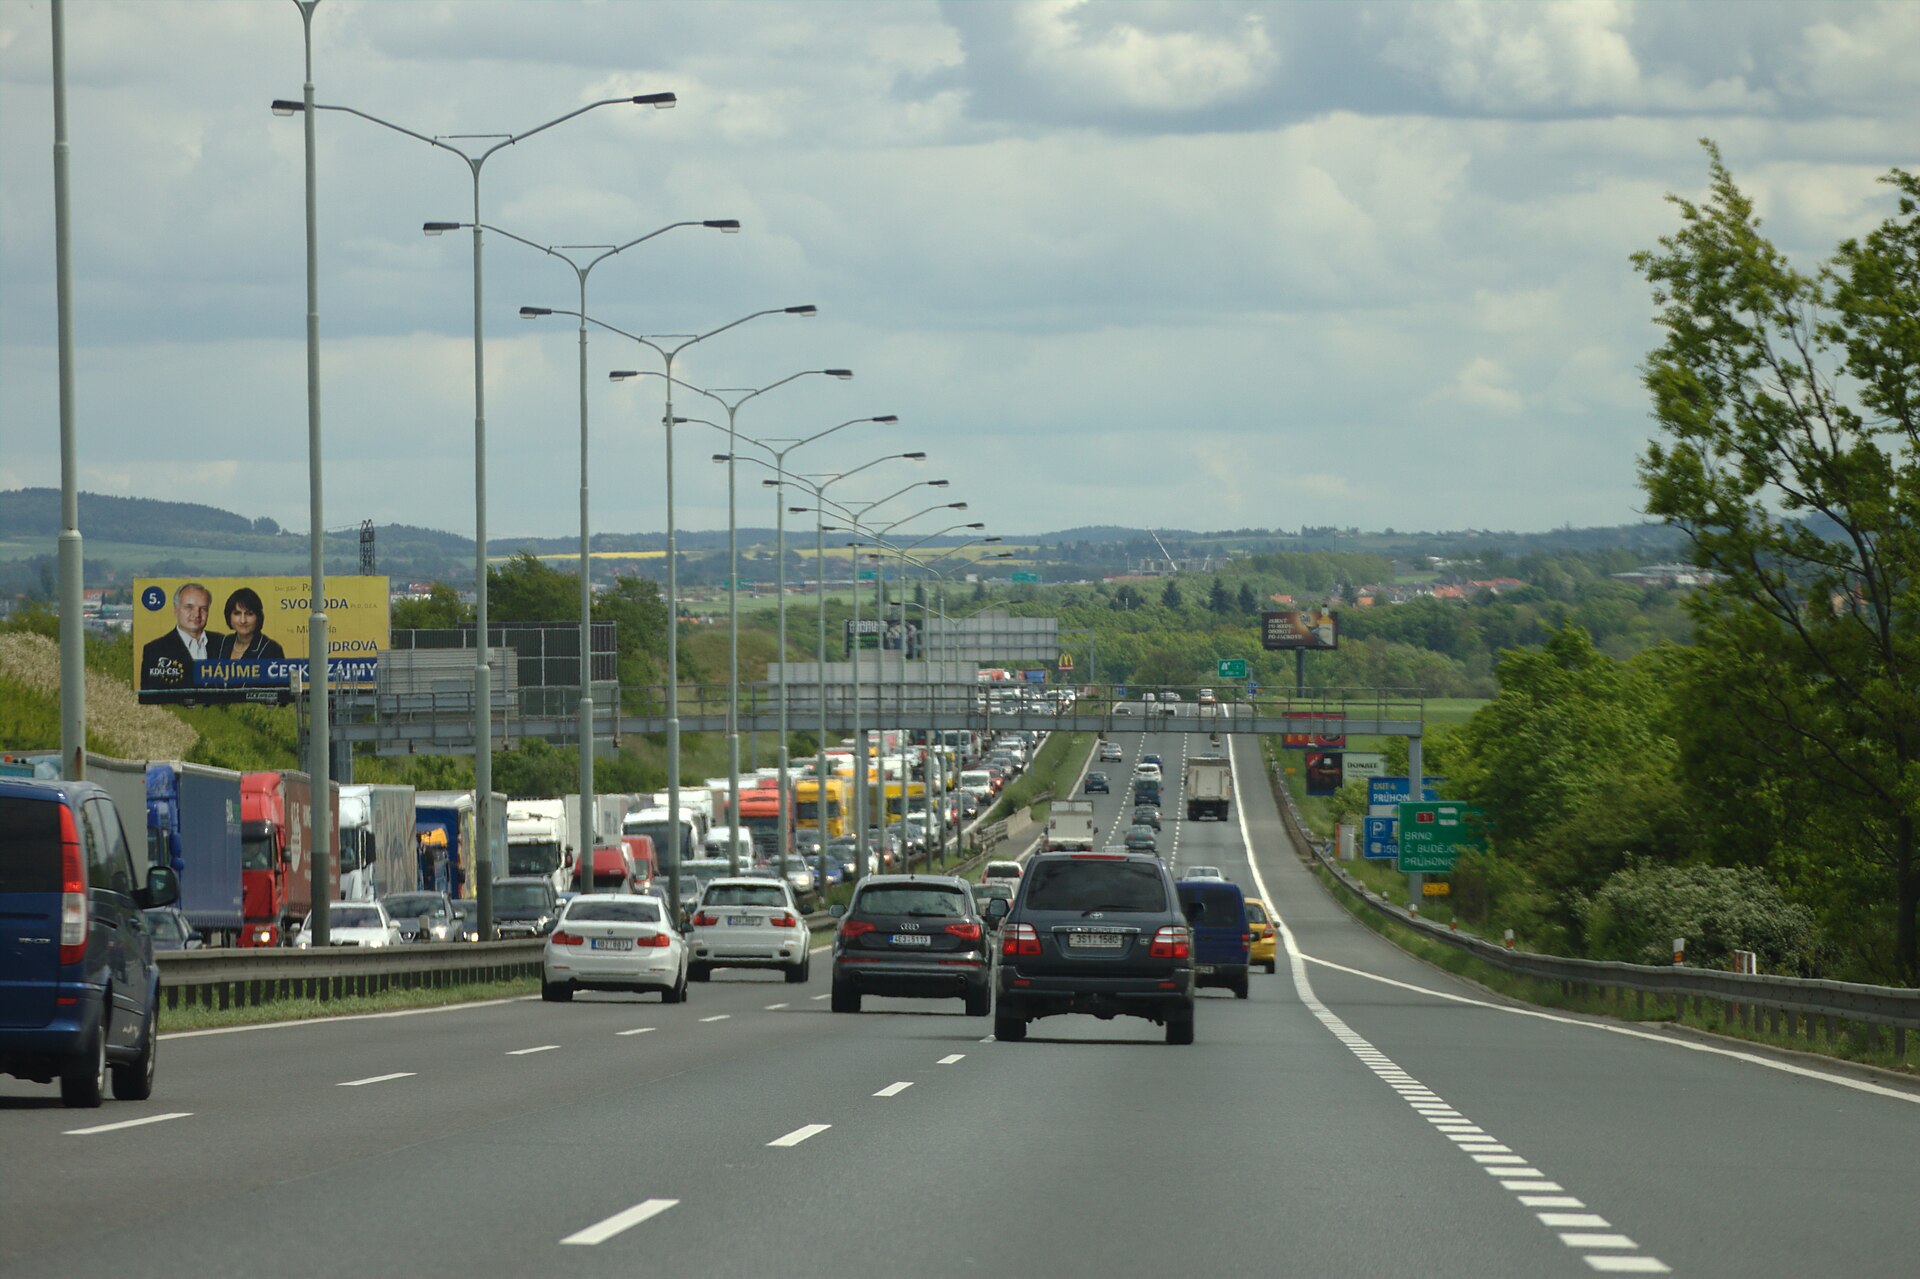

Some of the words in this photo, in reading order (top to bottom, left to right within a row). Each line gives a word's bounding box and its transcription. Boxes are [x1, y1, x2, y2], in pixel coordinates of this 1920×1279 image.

[149, 592, 161, 605] 5.
[201, 662, 260, 681] HÁJÍME
[1404, 832, 1433, 840] BRNO
